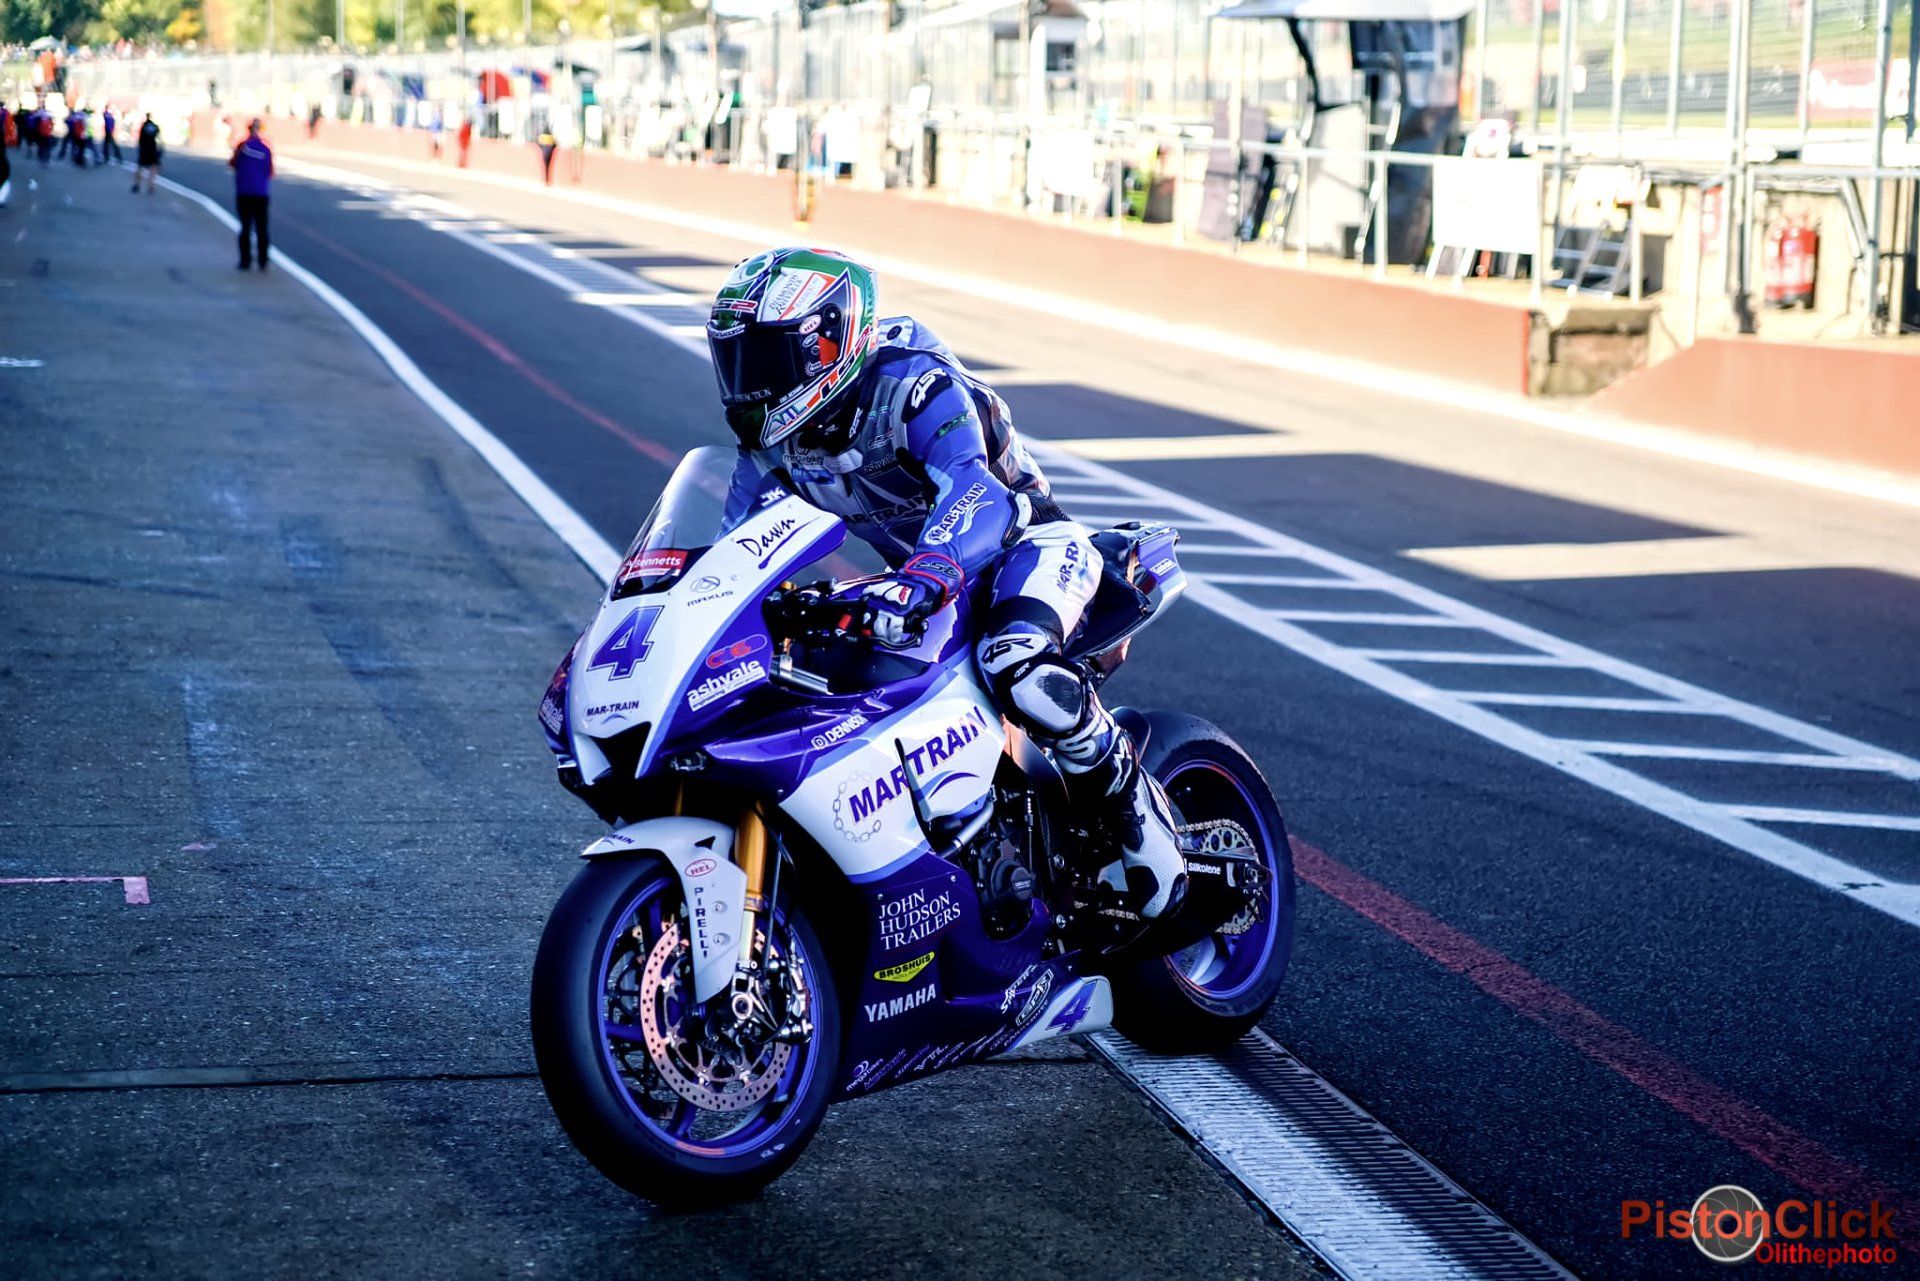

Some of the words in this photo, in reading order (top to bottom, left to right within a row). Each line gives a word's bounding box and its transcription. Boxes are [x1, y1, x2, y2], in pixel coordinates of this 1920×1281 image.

[929, 482, 986, 541] MAR-TRAIN
[736, 516, 795, 557] Dawn
[586, 605, 665, 681] 4
[686, 660, 760, 701] ashvale
[586, 701, 639, 717] MAR-TRAIN
[694, 887, 710, 958] PIRELLI
[878, 888, 925, 920] JOHN
[880, 891, 950, 935] HUDSON
[880, 902, 961, 950] TRAILERS
[879, 954, 931, 979] BROSHUIS
[864, 983, 936, 1022] YAMAHA
[1045, 978, 1098, 1036] 4
